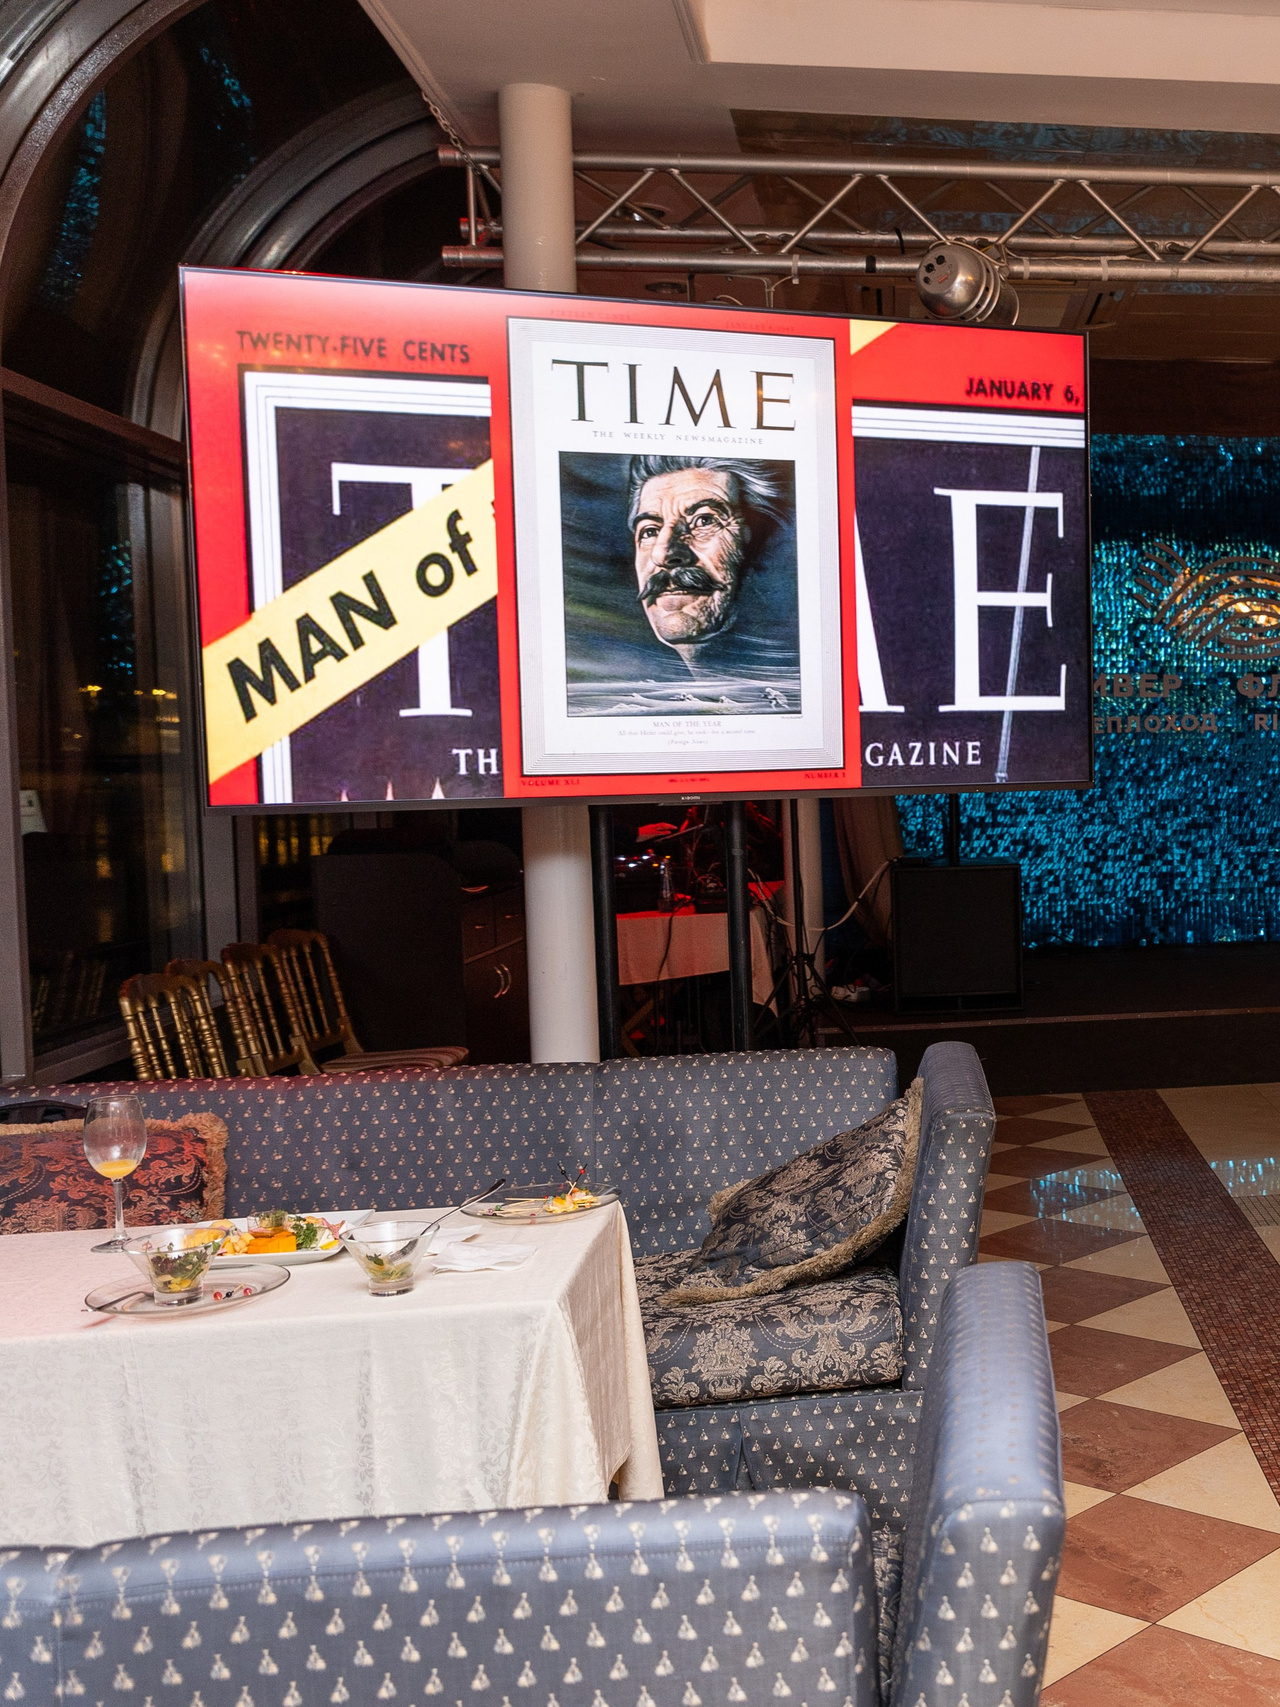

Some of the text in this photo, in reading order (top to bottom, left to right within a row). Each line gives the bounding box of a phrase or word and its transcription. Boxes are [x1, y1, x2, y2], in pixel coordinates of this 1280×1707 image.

[403, 340, 470, 363] CENTS
[551, 358, 796, 431] TIME
[965, 377, 1080, 405] JANUARY 6,
[593, 430, 764, 445] THE WEEKLY NEWSMAGAZINE
[226, 508, 478, 724] MAN of
[1093, 673, 1182, 697] ИВЕР
[1093, 714, 1218, 733] ЕПЛОХОД
[452, 741, 981, 775] TH GAZINE
[521, 779, 560, 787] VOLUME
